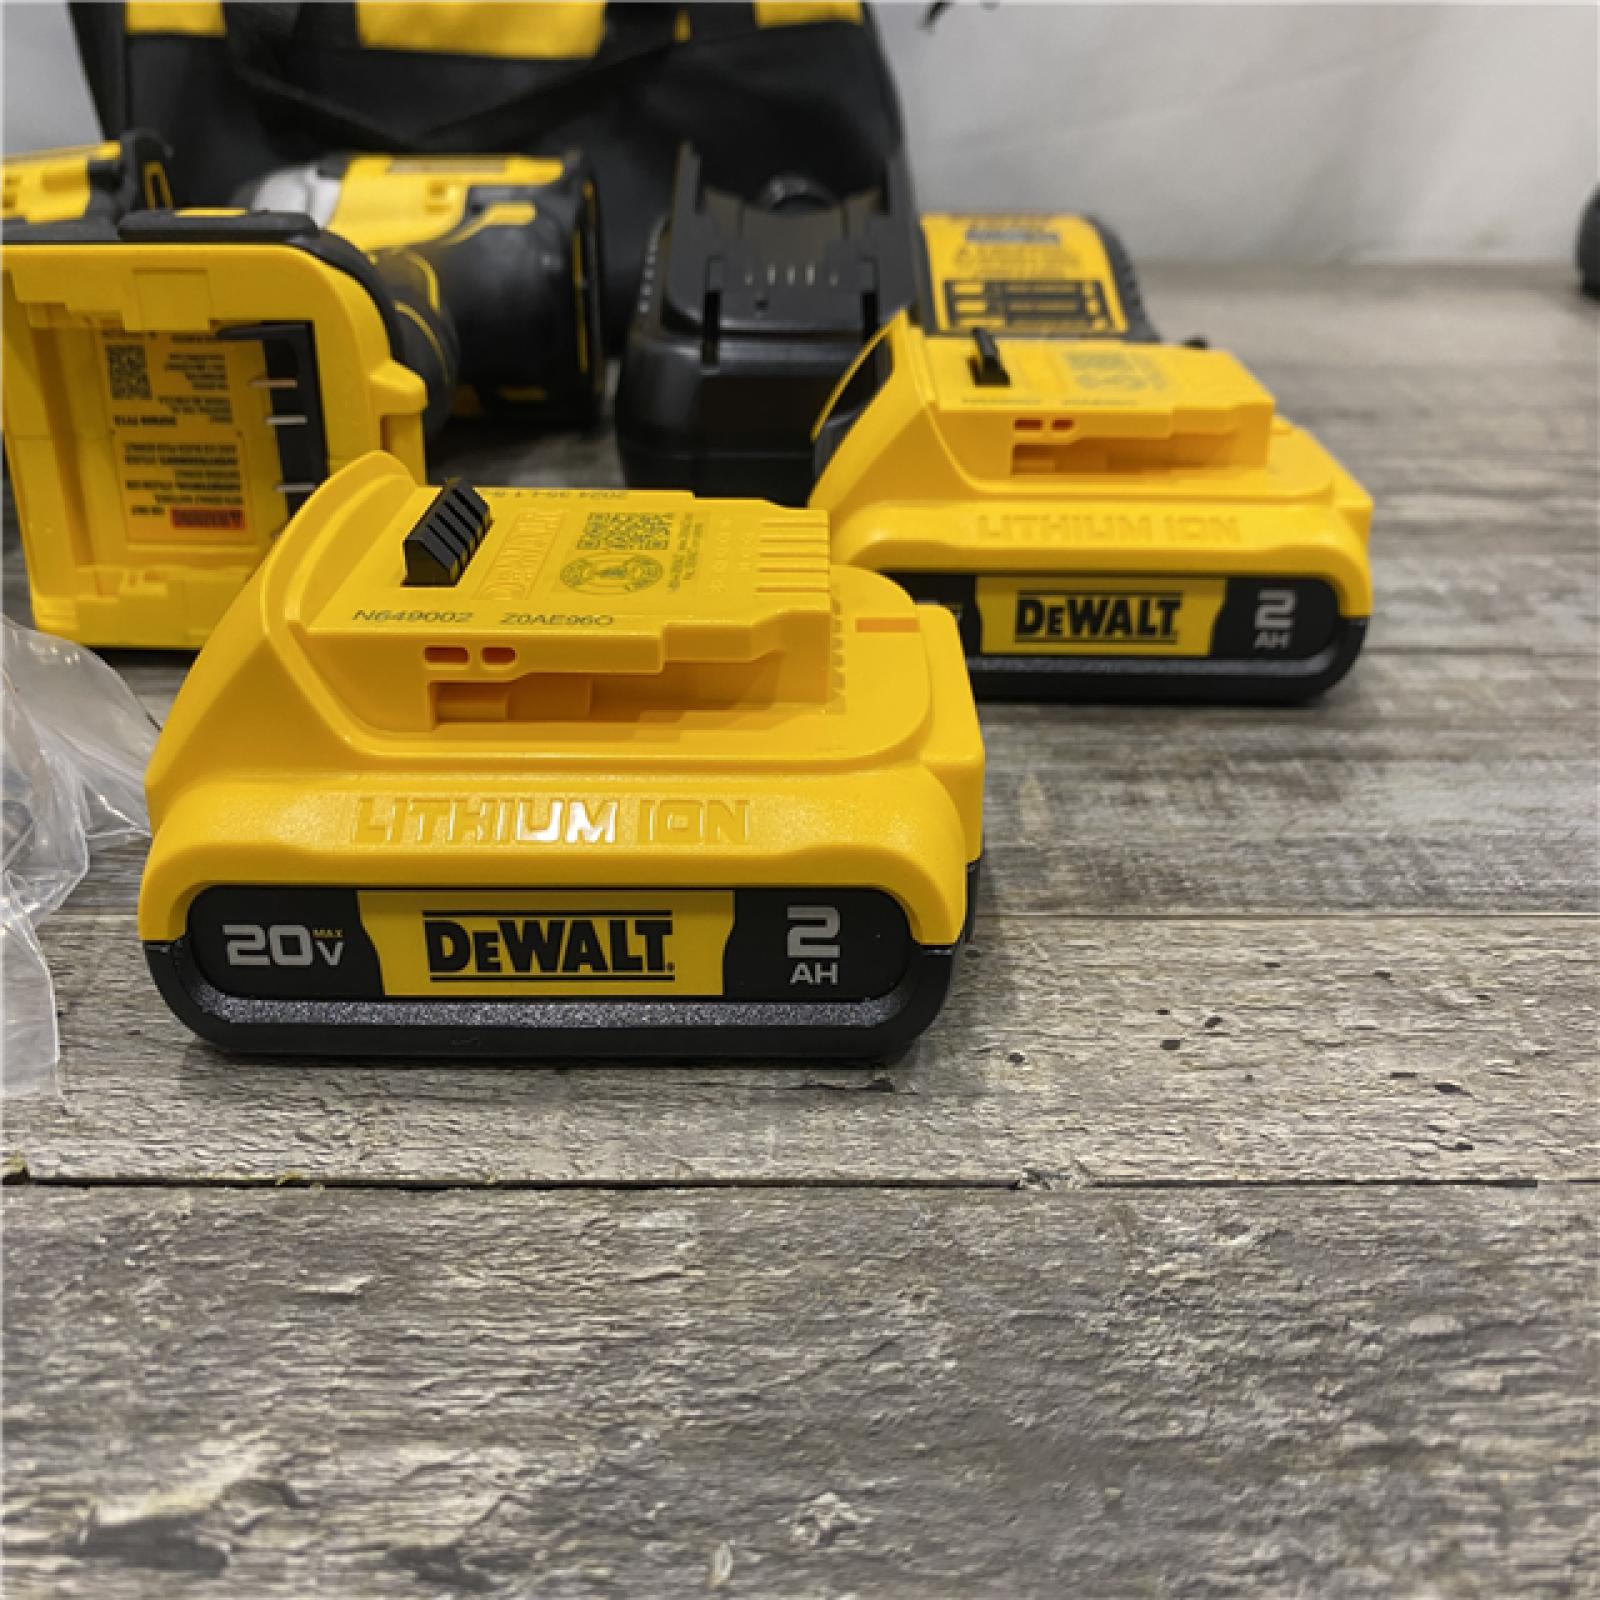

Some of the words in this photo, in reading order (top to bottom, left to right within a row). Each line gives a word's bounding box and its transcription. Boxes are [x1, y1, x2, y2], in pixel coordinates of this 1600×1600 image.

[977, 514, 1150, 542] LITHIUM
[1160, 514, 1241, 542] ION
[1016, 598, 1181, 635] DEWALT
[1255, 590, 1295, 629] 2
[1254, 632, 1289, 649] AH
[351, 797, 619, 844] LITHIUM
[637, 797, 751, 844] ION
[424, 919, 675, 973] DEWALT
[786, 905, 841, 958] 2
[789, 962, 838, 985] AH
